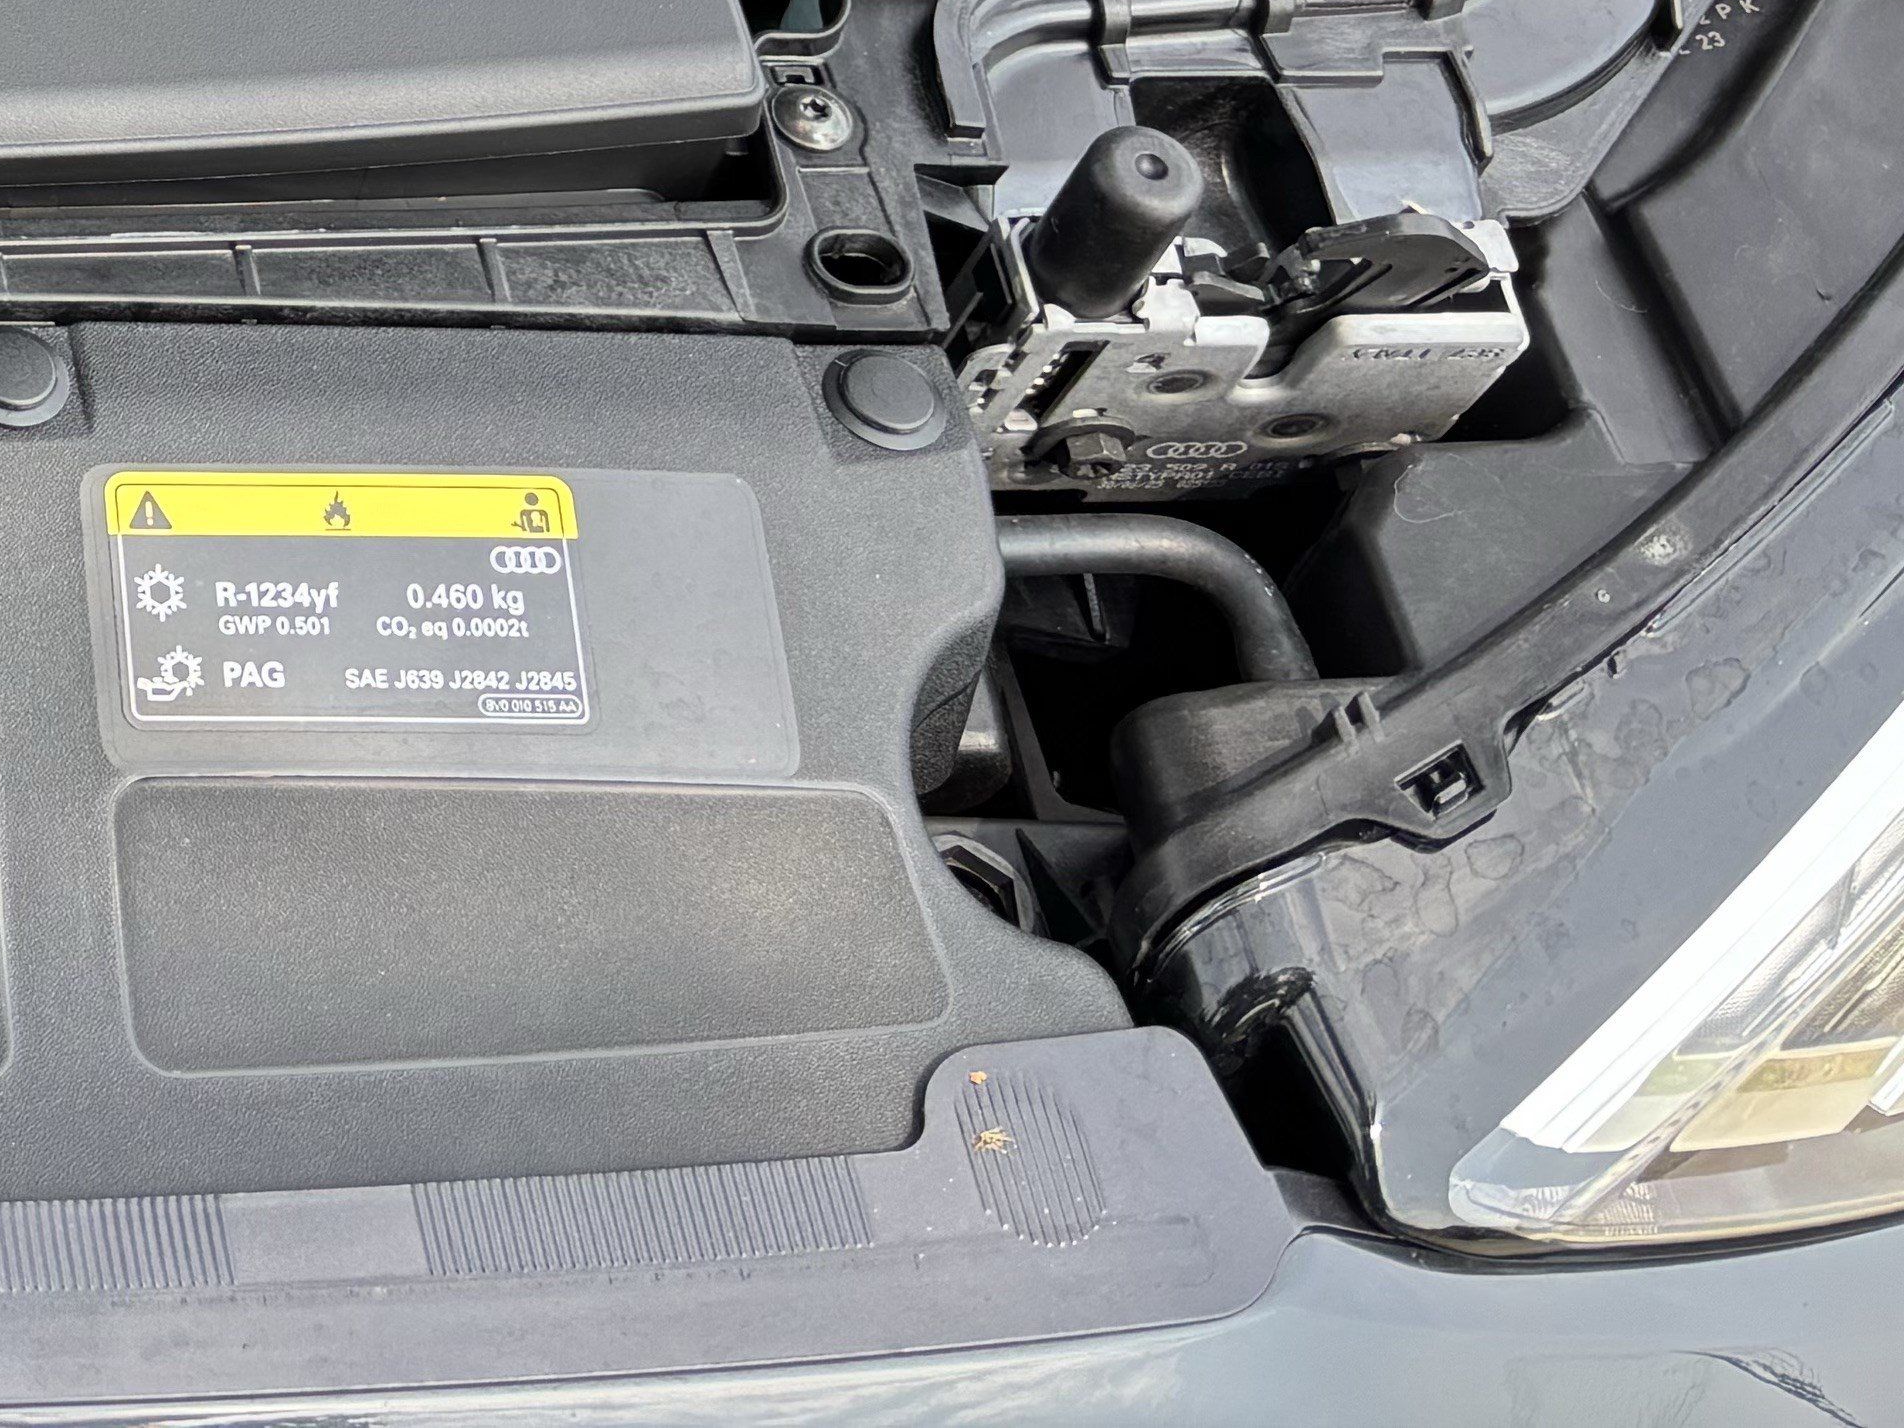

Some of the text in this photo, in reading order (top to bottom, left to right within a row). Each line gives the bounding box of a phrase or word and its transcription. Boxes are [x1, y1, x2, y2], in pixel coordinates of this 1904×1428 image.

[1714, 0, 1733, 21] P
[1694, 27, 1726, 53] 23
[215, 581, 338, 613] R-1234yf
[406, 583, 524, 615] 0.460 kg
[218, 614, 329, 635] GWP 0.501
[421, 621, 448, 639] eq
[451, 616, 529, 637] 0.0002t
[222, 660, 285, 688] PAG
[344, 667, 577, 691] SAE J639 J2842 J2845
